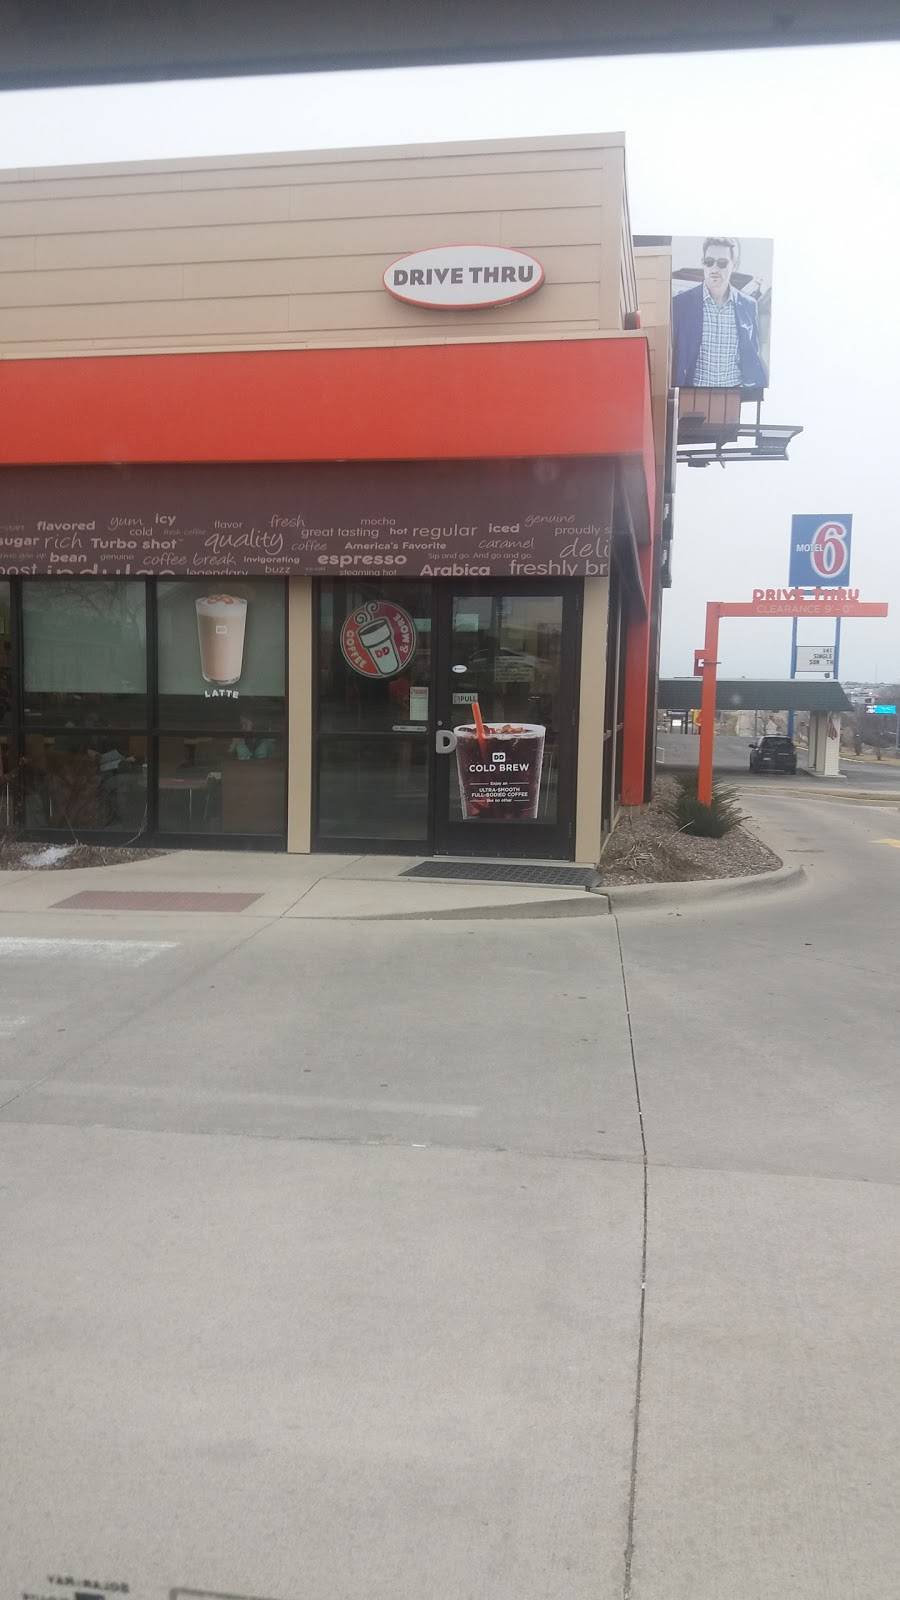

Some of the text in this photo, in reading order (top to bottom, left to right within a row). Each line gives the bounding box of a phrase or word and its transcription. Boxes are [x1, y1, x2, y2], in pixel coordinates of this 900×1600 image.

[393, 265, 534, 286] DRIVE THRU
[36, 520, 96, 531] flavored
[107, 516, 144, 532] yum
[214, 519, 243, 529] flavor
[270, 513, 306, 528] fresh
[360, 516, 396, 526] mocha
[525, 513, 576, 528] genuine
[129, 527, 153, 536] cold
[301, 527, 380, 539] great tasting
[389, 527, 408, 535] hot
[412, 523, 479, 540] regular
[554, 522, 600, 537] proudly
[44, 531, 83, 549] rich
[91, 537, 177, 550] Turbo shot
[204, 527, 284, 556] quality
[291, 538, 328, 552] coffee
[344, 541, 447, 551] America's Favorite
[478, 537, 535, 550] caramel
[795, 521, 849, 579] MOTEL 6
[49, 551, 87, 563] bean
[142, 552, 237, 567] coffee break
[318, 554, 408, 568] espresso
[264, 564, 291, 574] buzz
[419, 563, 491, 577] Arabica
[509, 559, 579, 577] freshly
[752, 588, 860, 601] DRIVE THRU
[757, 604, 821, 614] CLEARANCE
[346, 630, 367, 669] COFFEE
[392, 612, 410, 644] MORE
[204, 688, 239, 699] LATTE
[469, 763, 530, 772] COLD BREW
